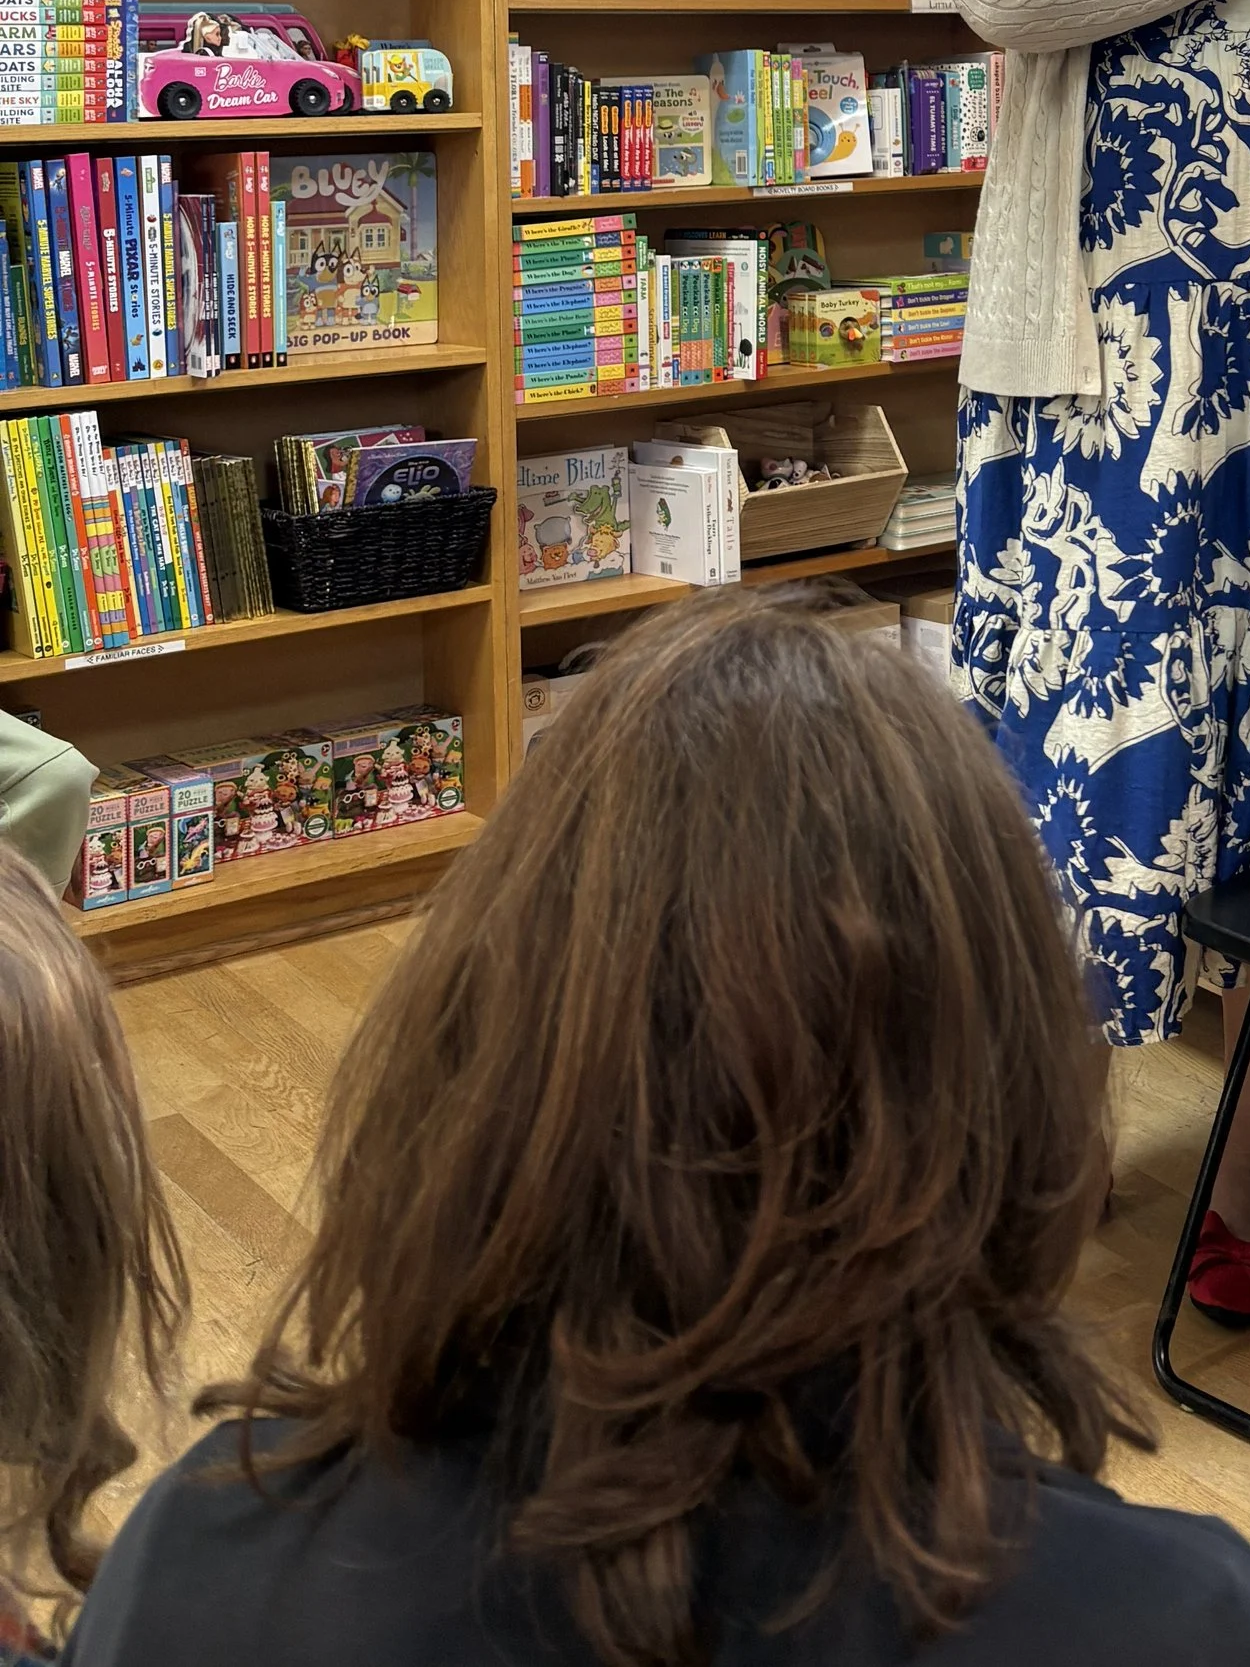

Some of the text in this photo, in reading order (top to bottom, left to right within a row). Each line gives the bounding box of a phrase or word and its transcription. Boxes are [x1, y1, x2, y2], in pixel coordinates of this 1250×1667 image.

[214, 62, 267, 92] Barbie
[813, 70, 859, 89] Touch,
[207, 89, 279, 111] Dream Car
[292, 160, 389, 206] BLUEY
[759, 246, 767, 274] NOISY
[227, 274, 235, 294] HIDE
[759, 275, 767, 316] ANIMAL
[820, 299, 860, 309] Baby Turkey
[228, 316, 236, 339] SEEK
[566, 454, 605, 486] Blitz!
[95, 646, 156, 662] FAMILIAR FACES
[178, 790, 191, 800] 20
[178, 796, 208, 808] PUZZLE
